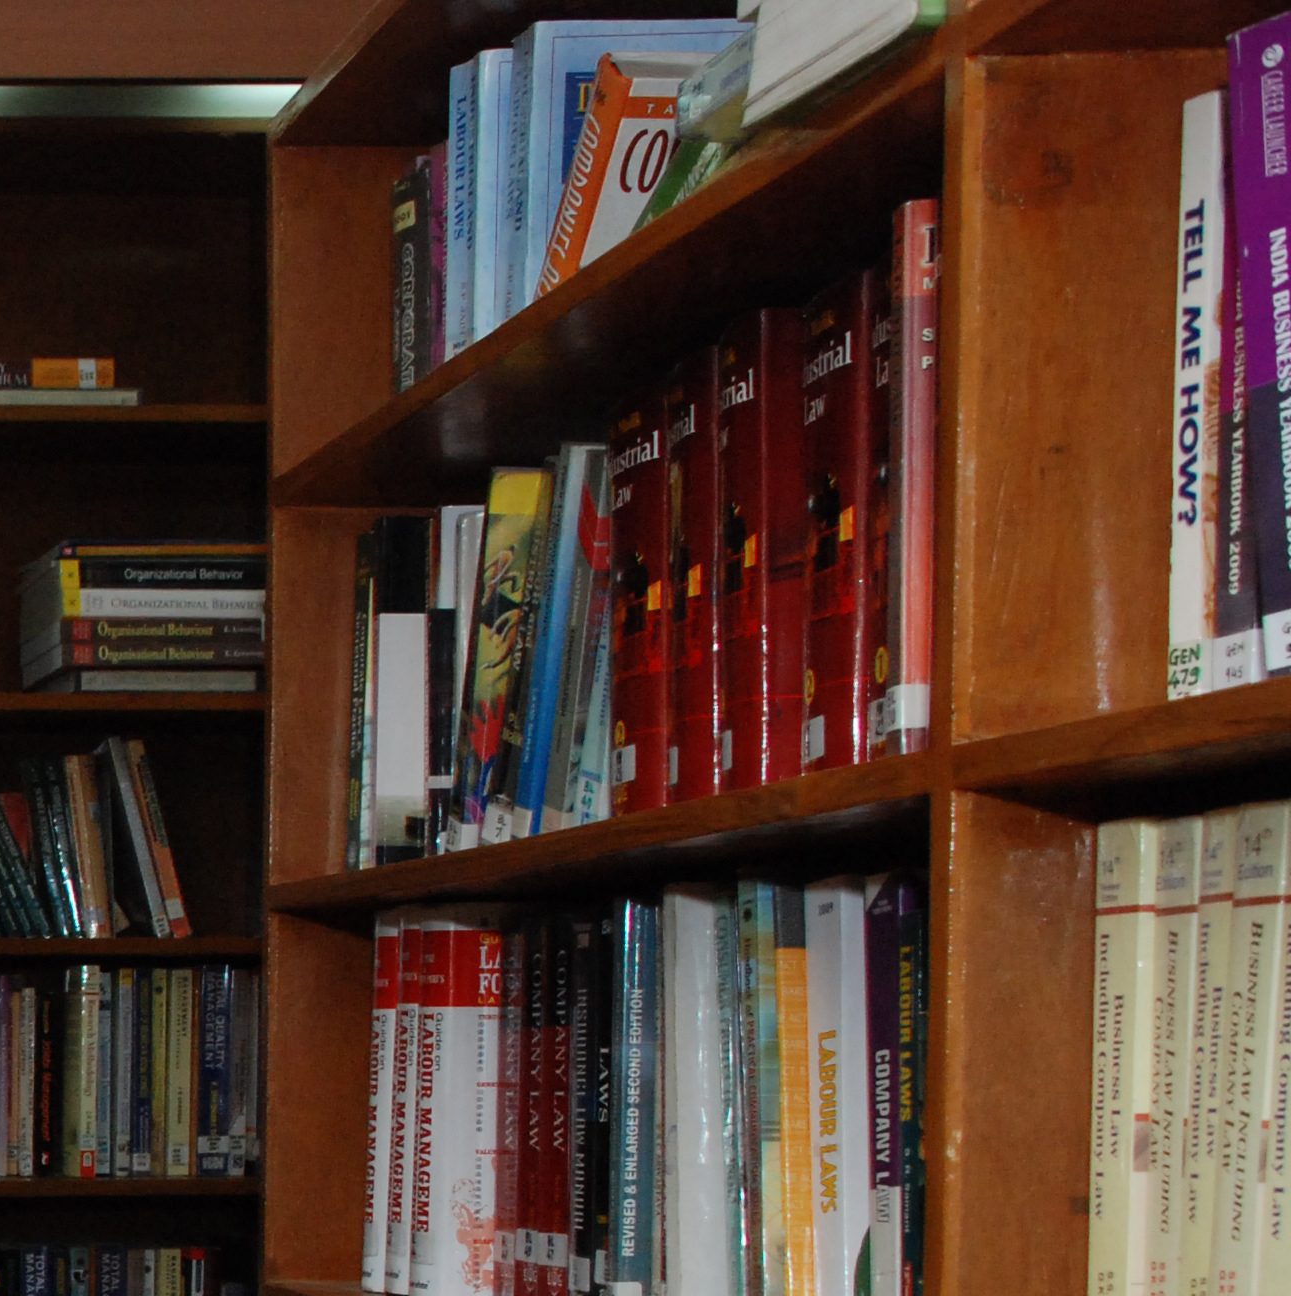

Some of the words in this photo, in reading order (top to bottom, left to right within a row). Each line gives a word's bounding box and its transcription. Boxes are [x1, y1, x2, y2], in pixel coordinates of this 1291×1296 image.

[456, 95, 469, 186] LABOUR
[454, 190, 467, 242] LAWS
[1183, 198, 1206, 295] TELL
[1269, 226, 1288, 281] INDIA
[1180, 305, 1202, 371] ME
[1176, 383, 1200, 529] HOW?
[204, 971, 216, 1070] MANAGEMENT
[528, 953, 541, 1080] COMPANY
[553, 948, 568, 1081] COMPANY
[628, 988, 643, 1044] EDITION
[898, 944, 913, 1053] LABOUR
[1096, 933, 1111, 1043] Including
[1165, 930, 1180, 1042] BUSINESS
[1194, 922, 1212, 1039] Including
[1245, 921, 1263, 1039] BUSINESS
[421, 1012, 435, 1102] LABOUR
[597, 1046, 610, 1124] LAWS
[627, 1048, 641, 1104] SECOND
[817, 1029, 837, 1136] LABOUR
[1110, 994, 1126, 1101] Business
[1163, 1049, 1175, 1101] LAW
[1206, 986, 1223, 1100] Business
[1222, 991, 1243, 1111] COMPANY
[1240, 1046, 1256, 1103] LAW
[526, 1091, 539, 1152] LAW
[550, 1090, 565, 1152] LAW
[873, 1048, 891, 1167] COMPANY
[899, 1057, 911, 1122] LAWS
[1092, 1051, 1108, 1163] Company
[1189, 1046, 1206, 1164] Company
[1272, 1053, 1291, 1177] Company
[417, 1107, 432, 1233] MANAGEME
[624, 1107, 639, 1180] ENLARGED
[1109, 1109, 1122, 1159] Law
[1159, 1108, 1174, 1235] INCLUDING
[1205, 1107, 1218, 1160] Law
[1219, 1119, 1235, 1175] LAW
[623, 1185, 635, 1196] &
[818, 1137, 837, 1216] LAWS
[1092, 1171, 1106, 1220] Law
[1187, 1172, 1200, 1225] Law
[1230, 1110, 1252, 1242] INCLUDING
[1270, 1184, 1285, 1242] Law
[622, 1199, 635, 1257] REVISED
[35, 1253, 45, 1290] TOTAL
[110, 1253, 120, 1290] TOTAL
